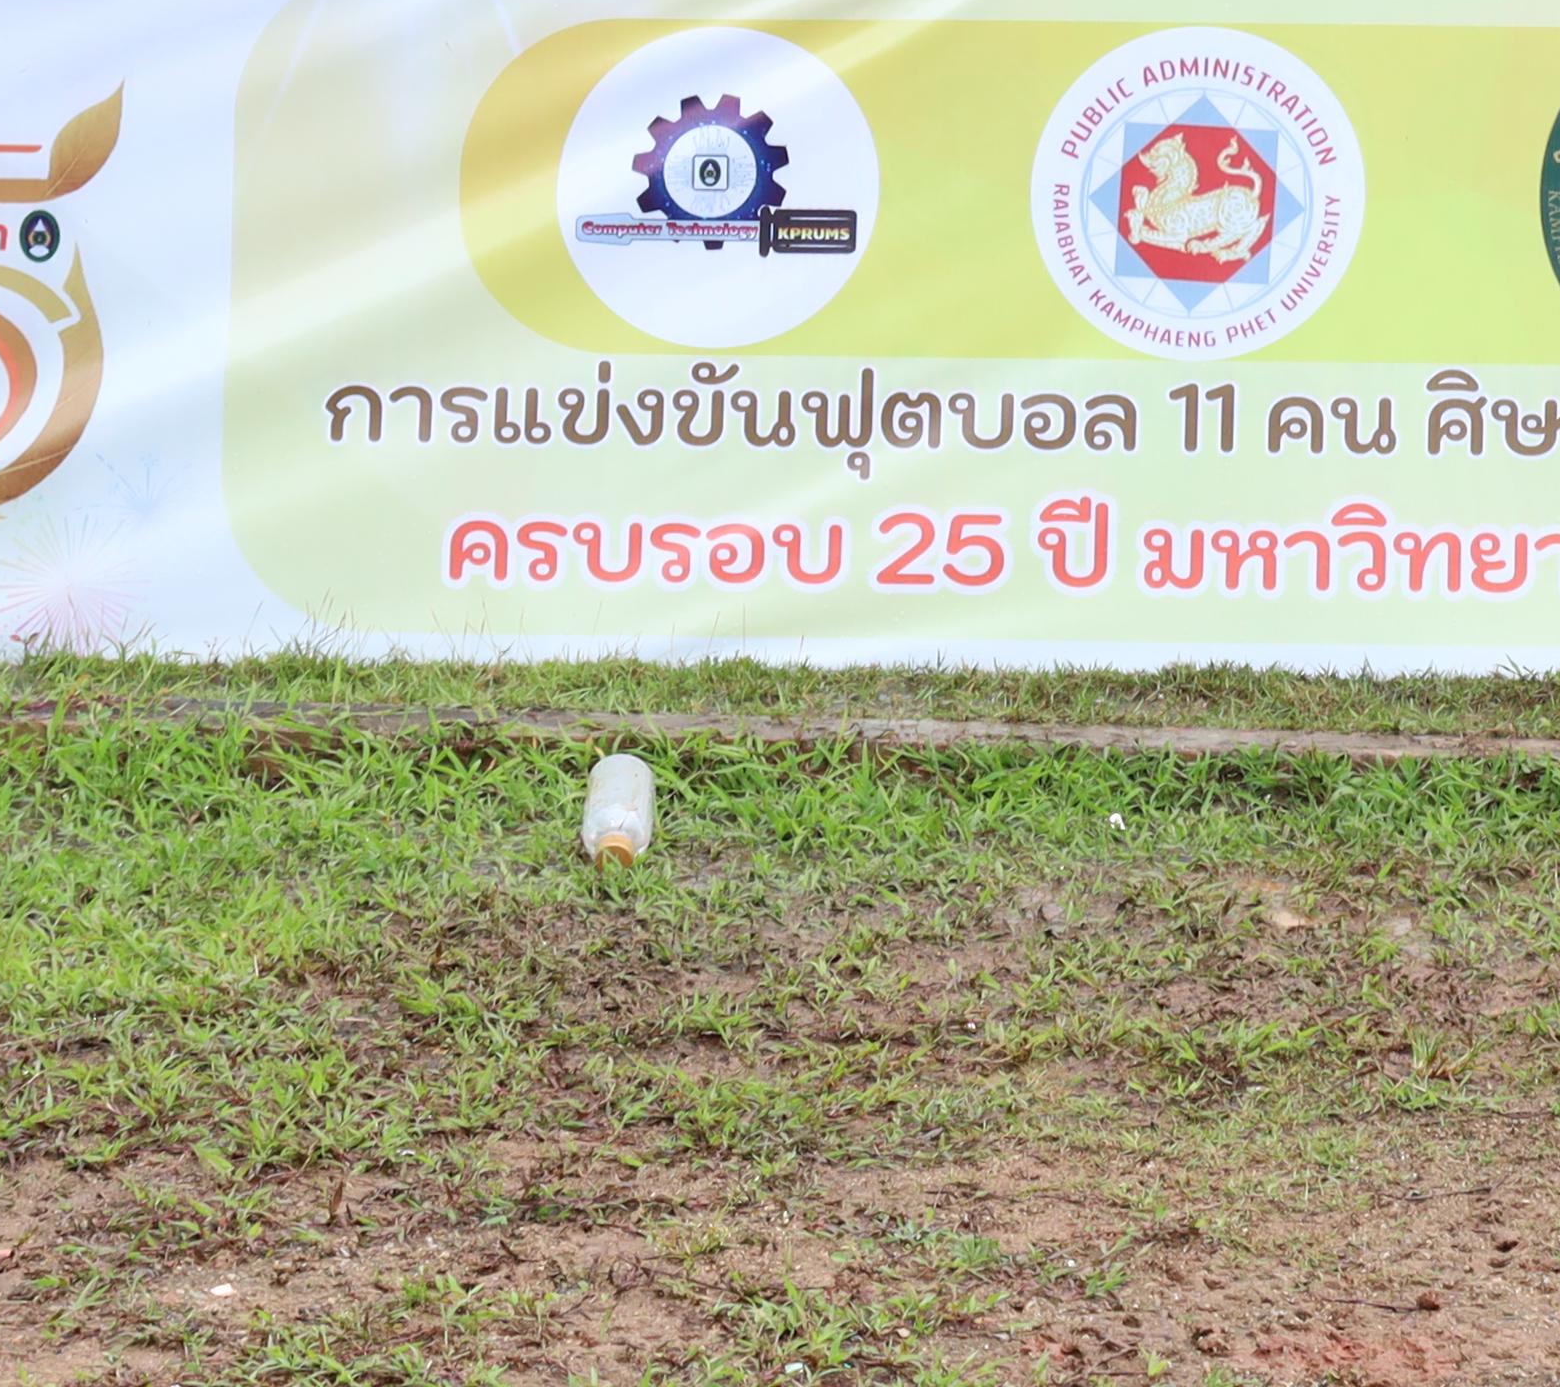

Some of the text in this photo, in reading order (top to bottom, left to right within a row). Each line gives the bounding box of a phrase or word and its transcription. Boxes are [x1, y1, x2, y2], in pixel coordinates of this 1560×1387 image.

[1060, 57, 1337, 166] PUBLIC ADMINISTRATION
[582, 221, 850, 241] Computer Technology KPRUMS
[1090, 290, 1216, 347] KAMPHAENG
[1227, 309, 1278, 343] PHET
[1281, 195, 1341, 311] UNIVERSITY
[325, 361, 1138, 479] การแข่งขันฟุตบอล
[1170, 384, 1232, 453] 11
[1267, 397, 1396, 454] คน
[449, 518, 842, 583] ครบรอบ
[875, 513, 1005, 586] 25
[1040, 497, 1109, 588] ปี
